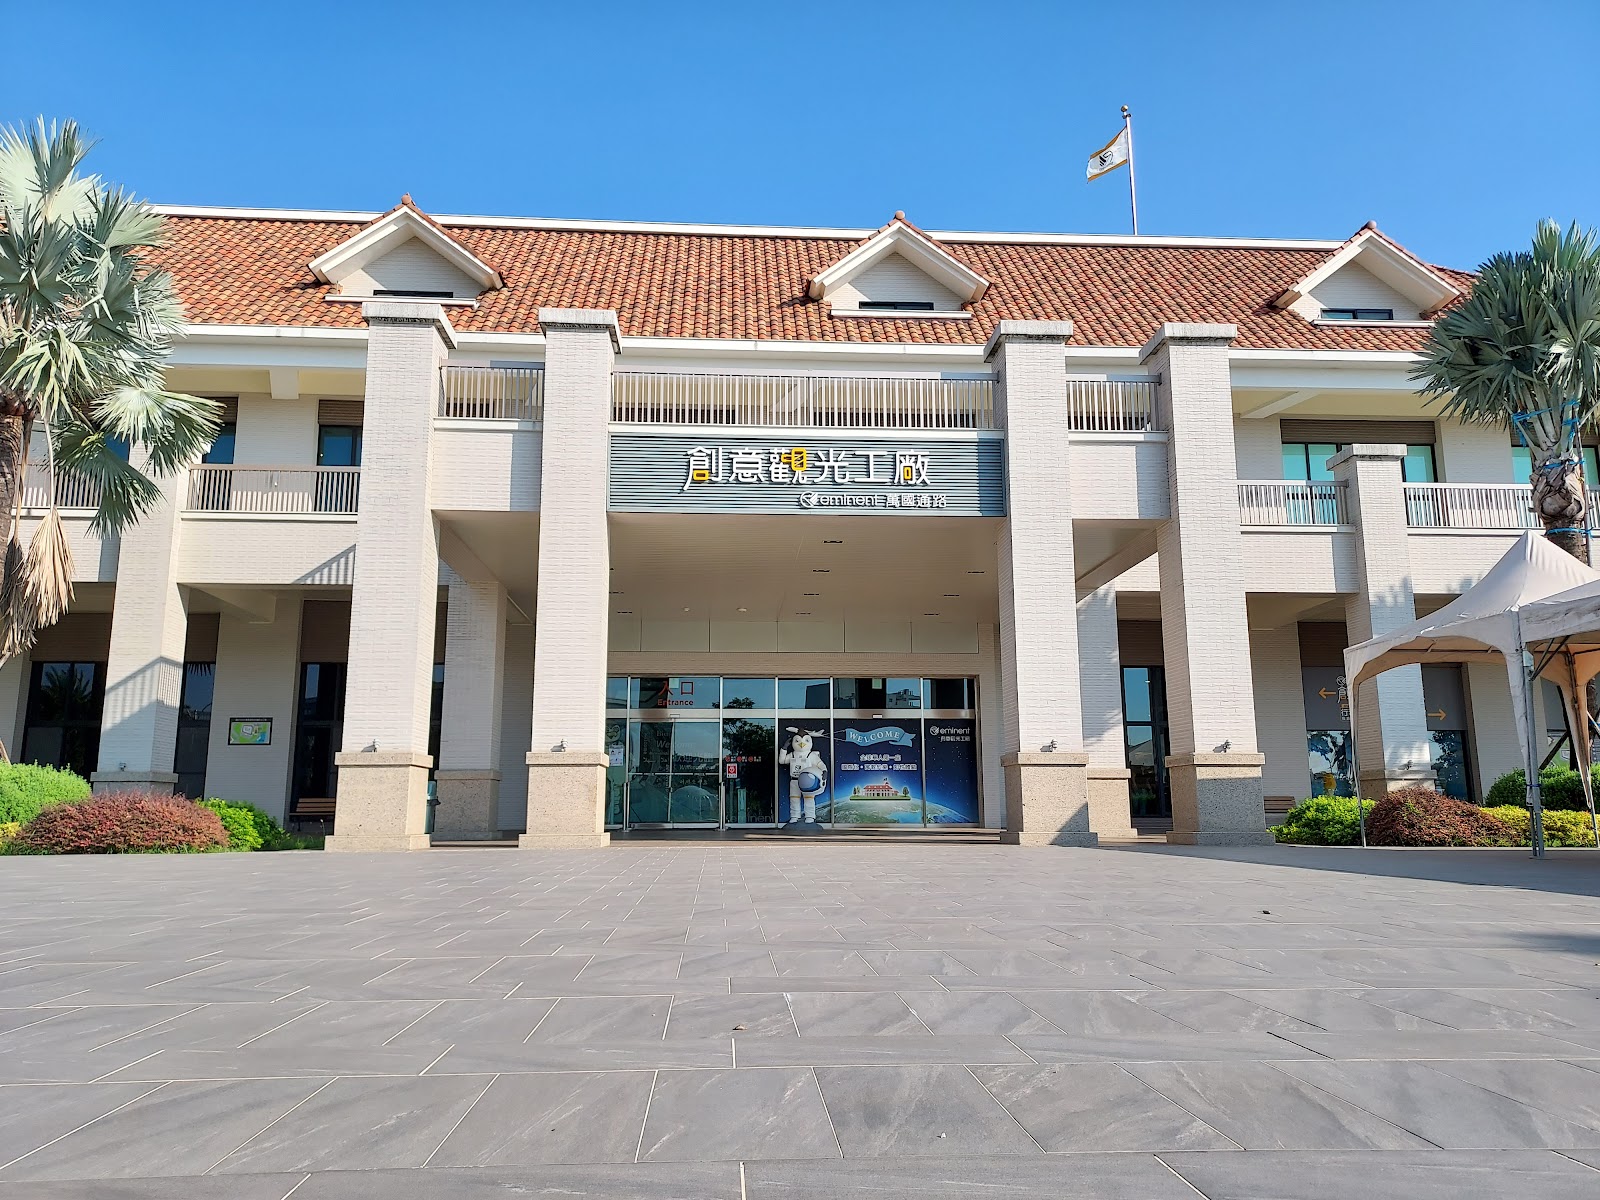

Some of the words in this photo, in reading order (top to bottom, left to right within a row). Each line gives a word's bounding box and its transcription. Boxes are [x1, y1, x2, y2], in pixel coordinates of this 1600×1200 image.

[682, 446, 931, 491] 創意觀光工廠
[820, 493, 880, 506] eminent
[885, 493, 947, 508] 萬國通路
[658, 680, 694, 695] 入口
[849, 729, 900, 743] WELCOME
[940, 726, 970, 735] eminent
